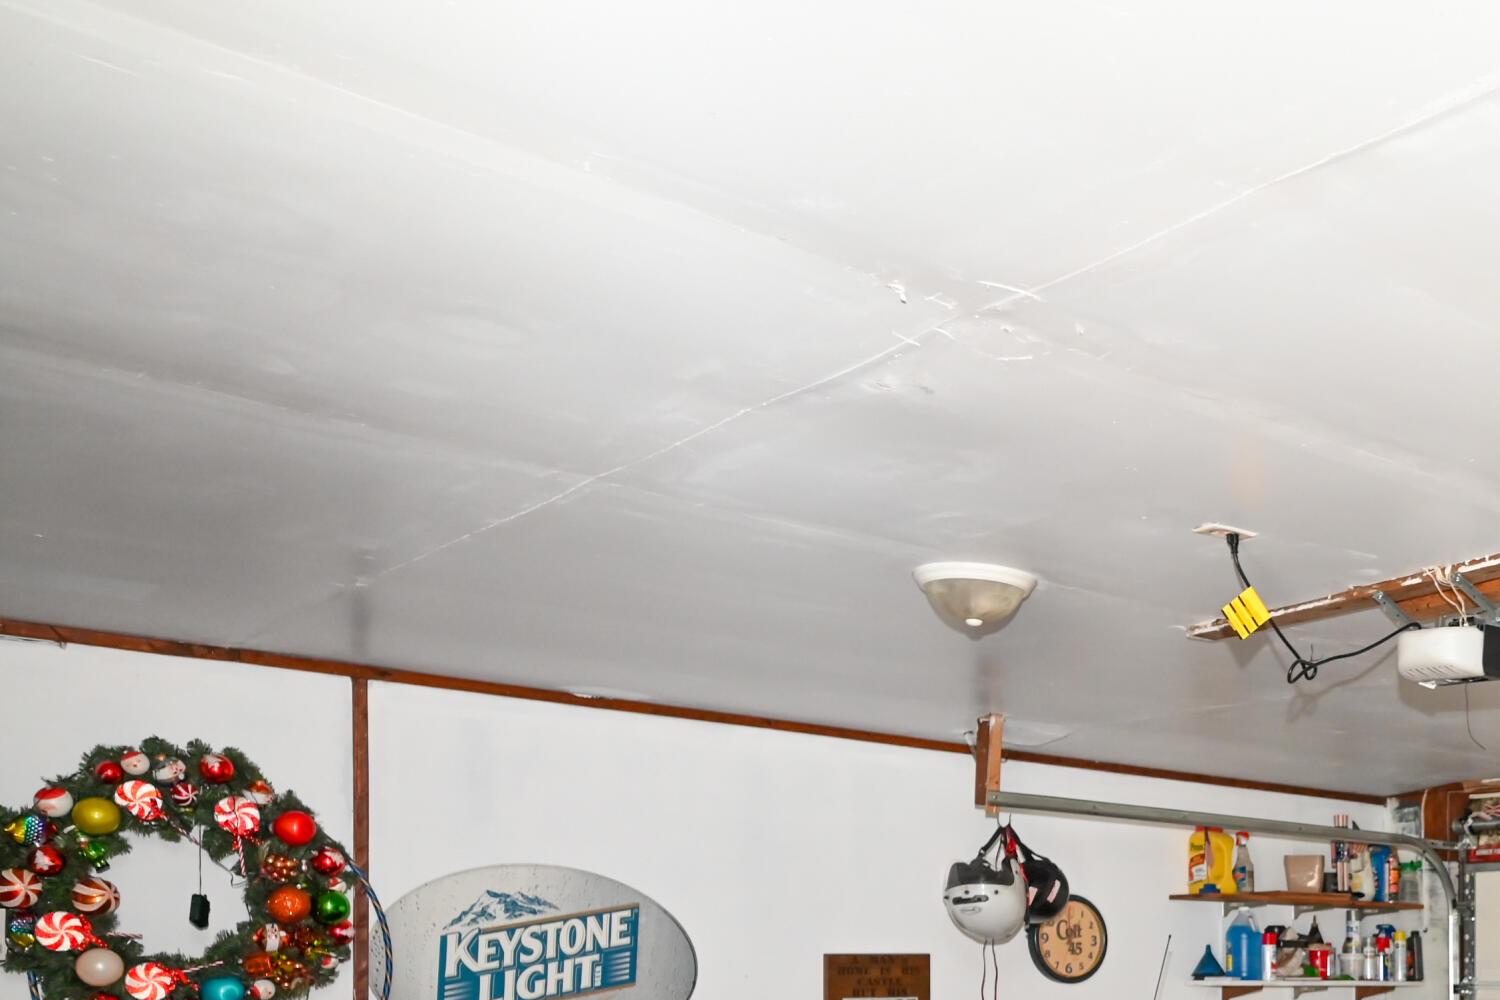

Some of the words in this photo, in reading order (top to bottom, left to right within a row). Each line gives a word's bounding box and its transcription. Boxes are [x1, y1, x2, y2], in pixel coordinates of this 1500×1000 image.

[1041, 932, 1049, 943] 9
[1091, 936, 1097, 946] 3
[444, 909, 632, 978] KEYSTONE
[1065, 963, 1072, 973] 6
